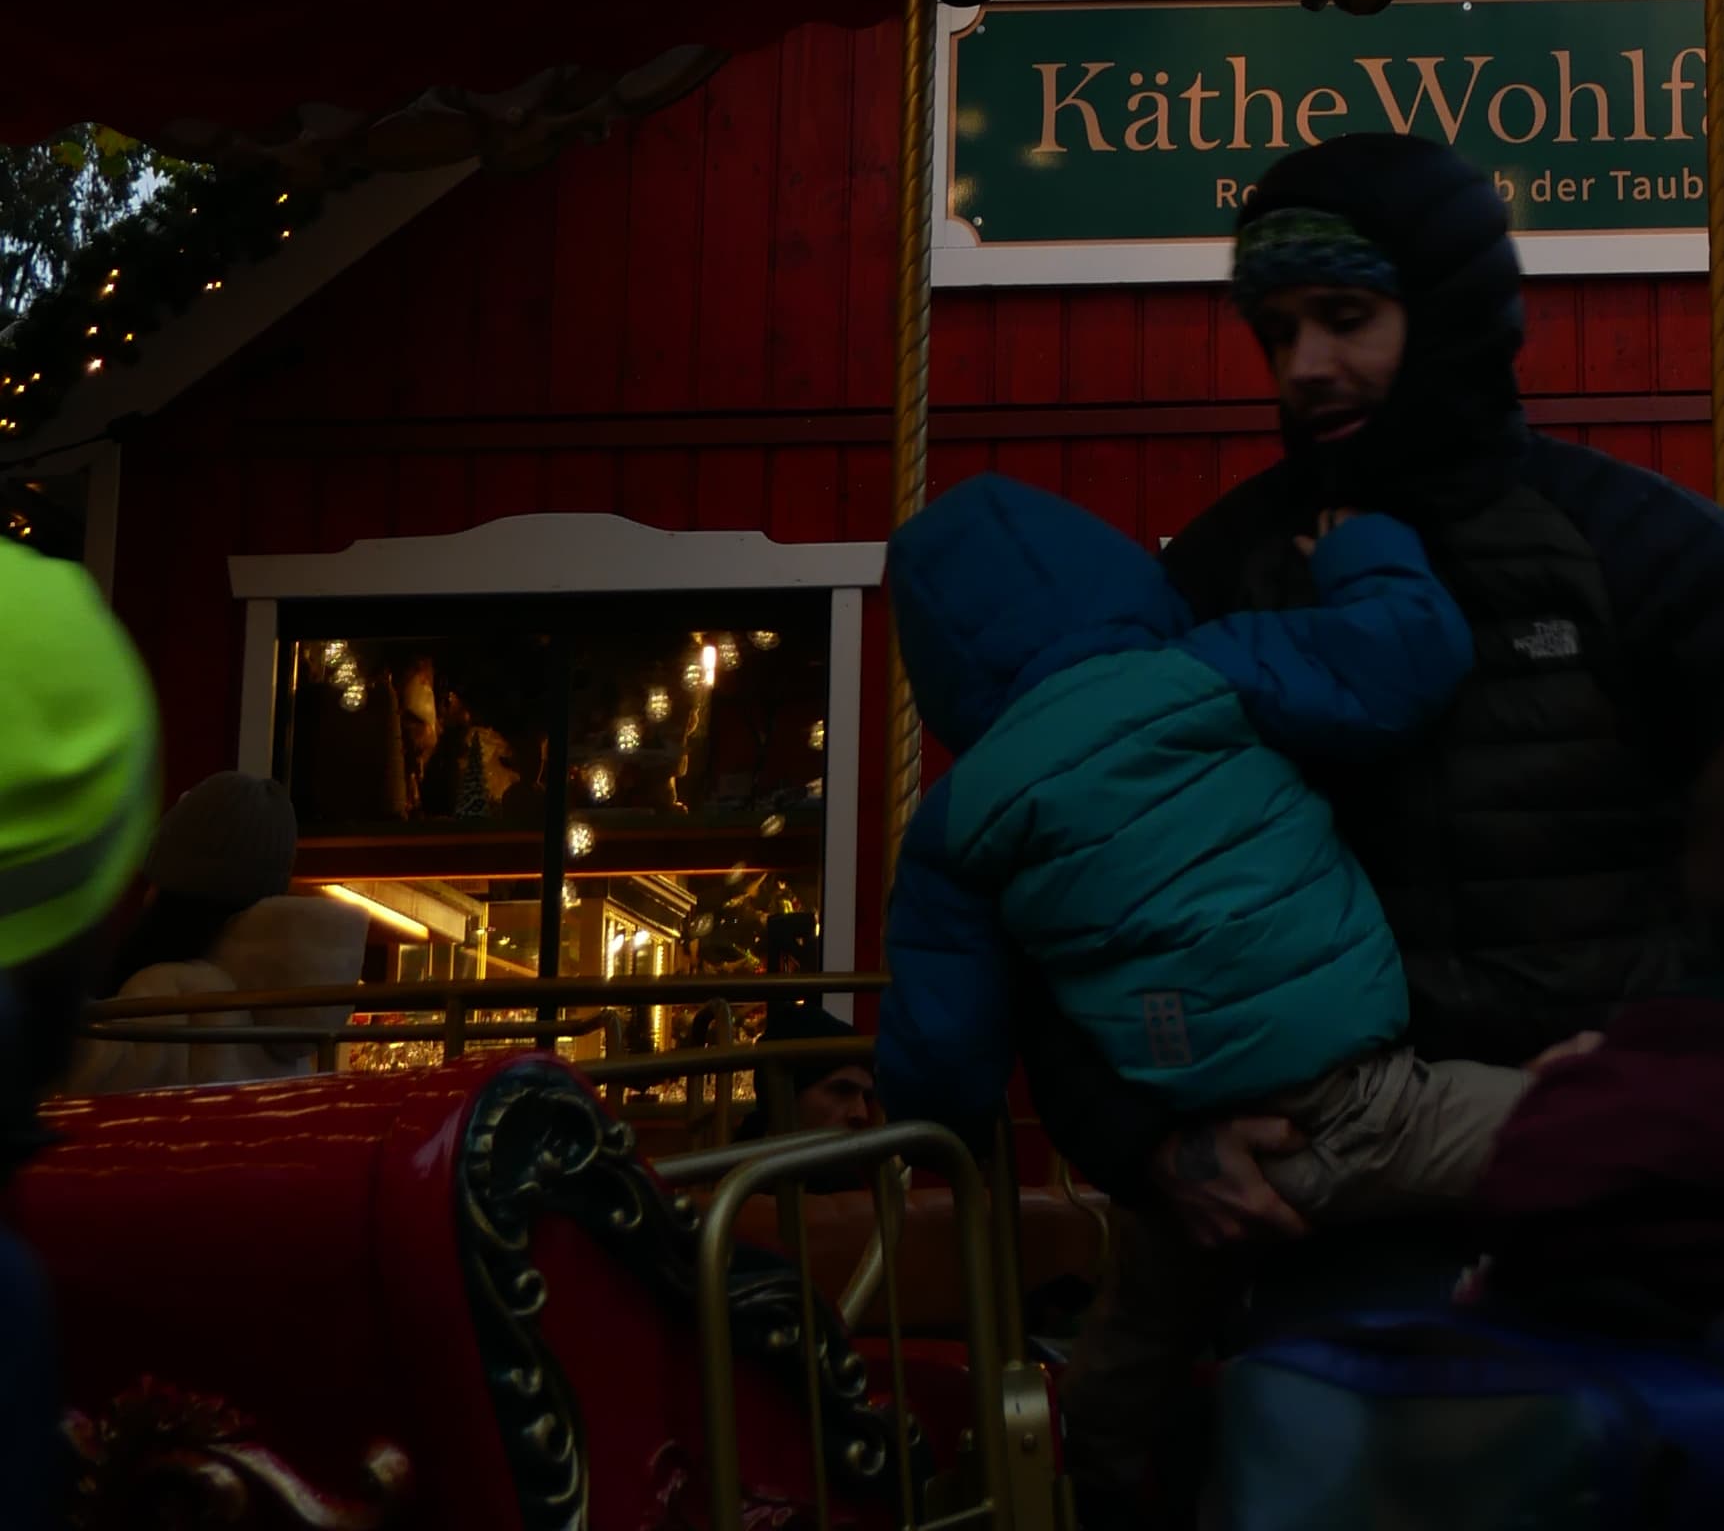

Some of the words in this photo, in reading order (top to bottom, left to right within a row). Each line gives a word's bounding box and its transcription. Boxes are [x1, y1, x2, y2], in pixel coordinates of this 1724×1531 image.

[1031, 55, 1348, 154] Käthe
[1530, 170, 1595, 203] der
[1608, 168, 1705, 203] Taub
